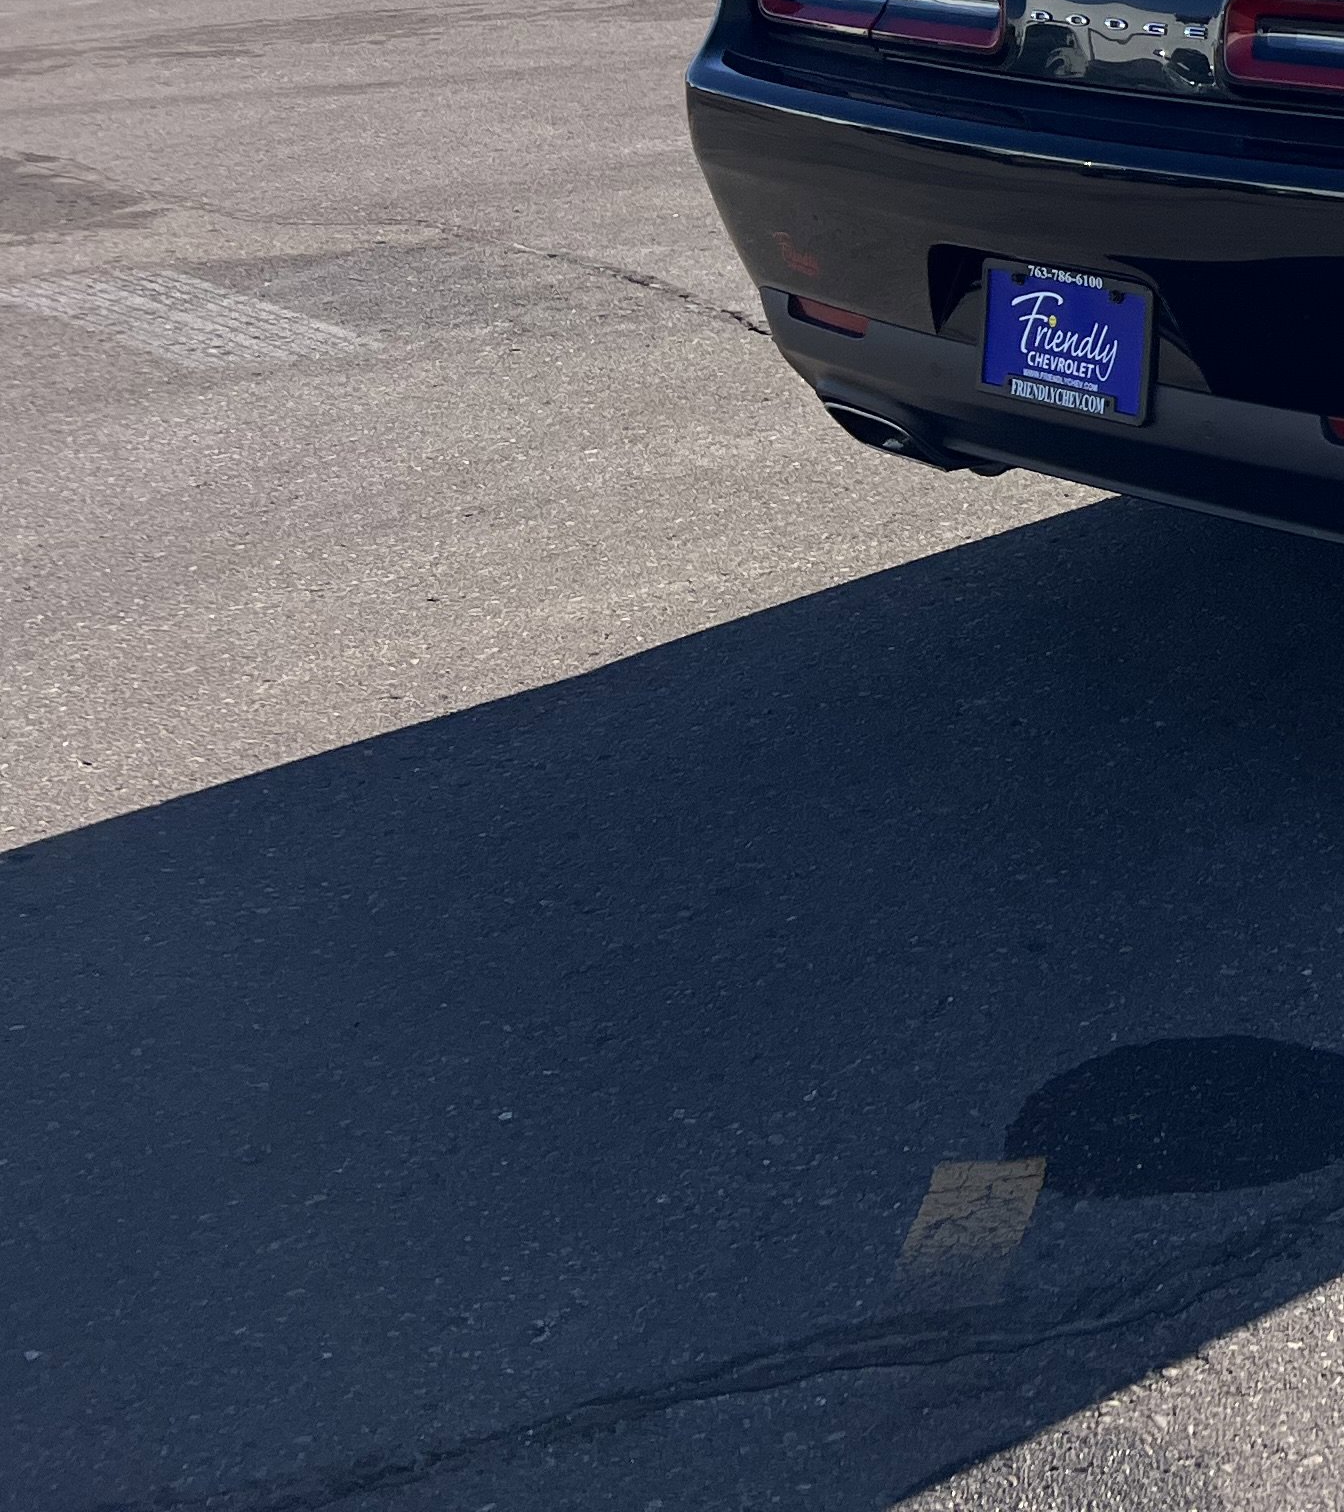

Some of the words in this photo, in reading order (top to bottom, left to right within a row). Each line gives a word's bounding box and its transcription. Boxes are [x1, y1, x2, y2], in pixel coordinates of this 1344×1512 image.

[1030, 10, 1208, 39] DODGE
[1028, 265, 1104, 290] 763-786-6100
[1011, 291, 1118, 382] Friendly
[1027, 351, 1095, 379] CHEVROLET
[1010, 378, 1105, 415] FRIENDLYCHEV.COM
